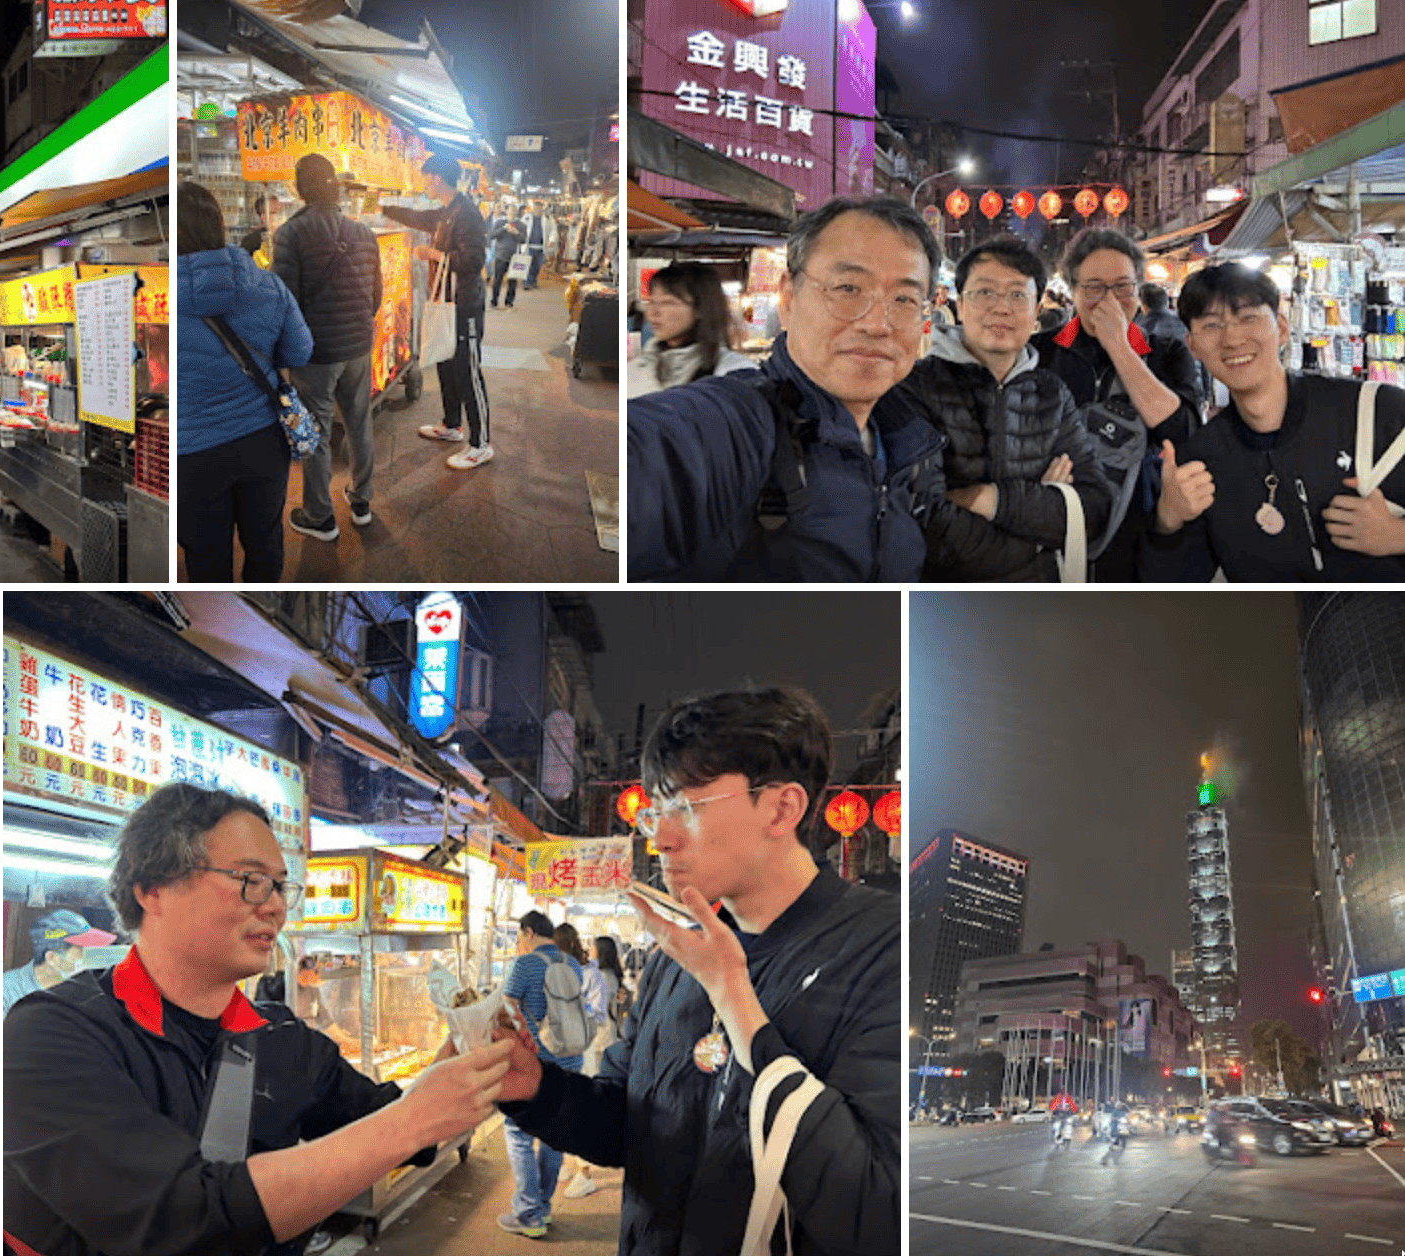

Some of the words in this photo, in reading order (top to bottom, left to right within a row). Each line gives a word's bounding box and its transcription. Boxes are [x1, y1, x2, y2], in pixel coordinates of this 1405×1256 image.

[686, 30, 807, 90] 金興發
[245, 103, 324, 150] 北京羊肉串
[675, 81, 813, 136] 生活百貨
[19, 652, 39, 741] 雞蛋牛奶
[45, 664, 64, 748] 牛奶
[68, 673, 86, 756] 花生大豆
[90, 682, 107, 763] 花生
[131, 699, 145, 774] 巧克力
[19, 766, 36, 785] 元
[45, 772, 61, 791] 元
[70, 779, 84, 797] 元
[93, 786, 106, 802] 元
